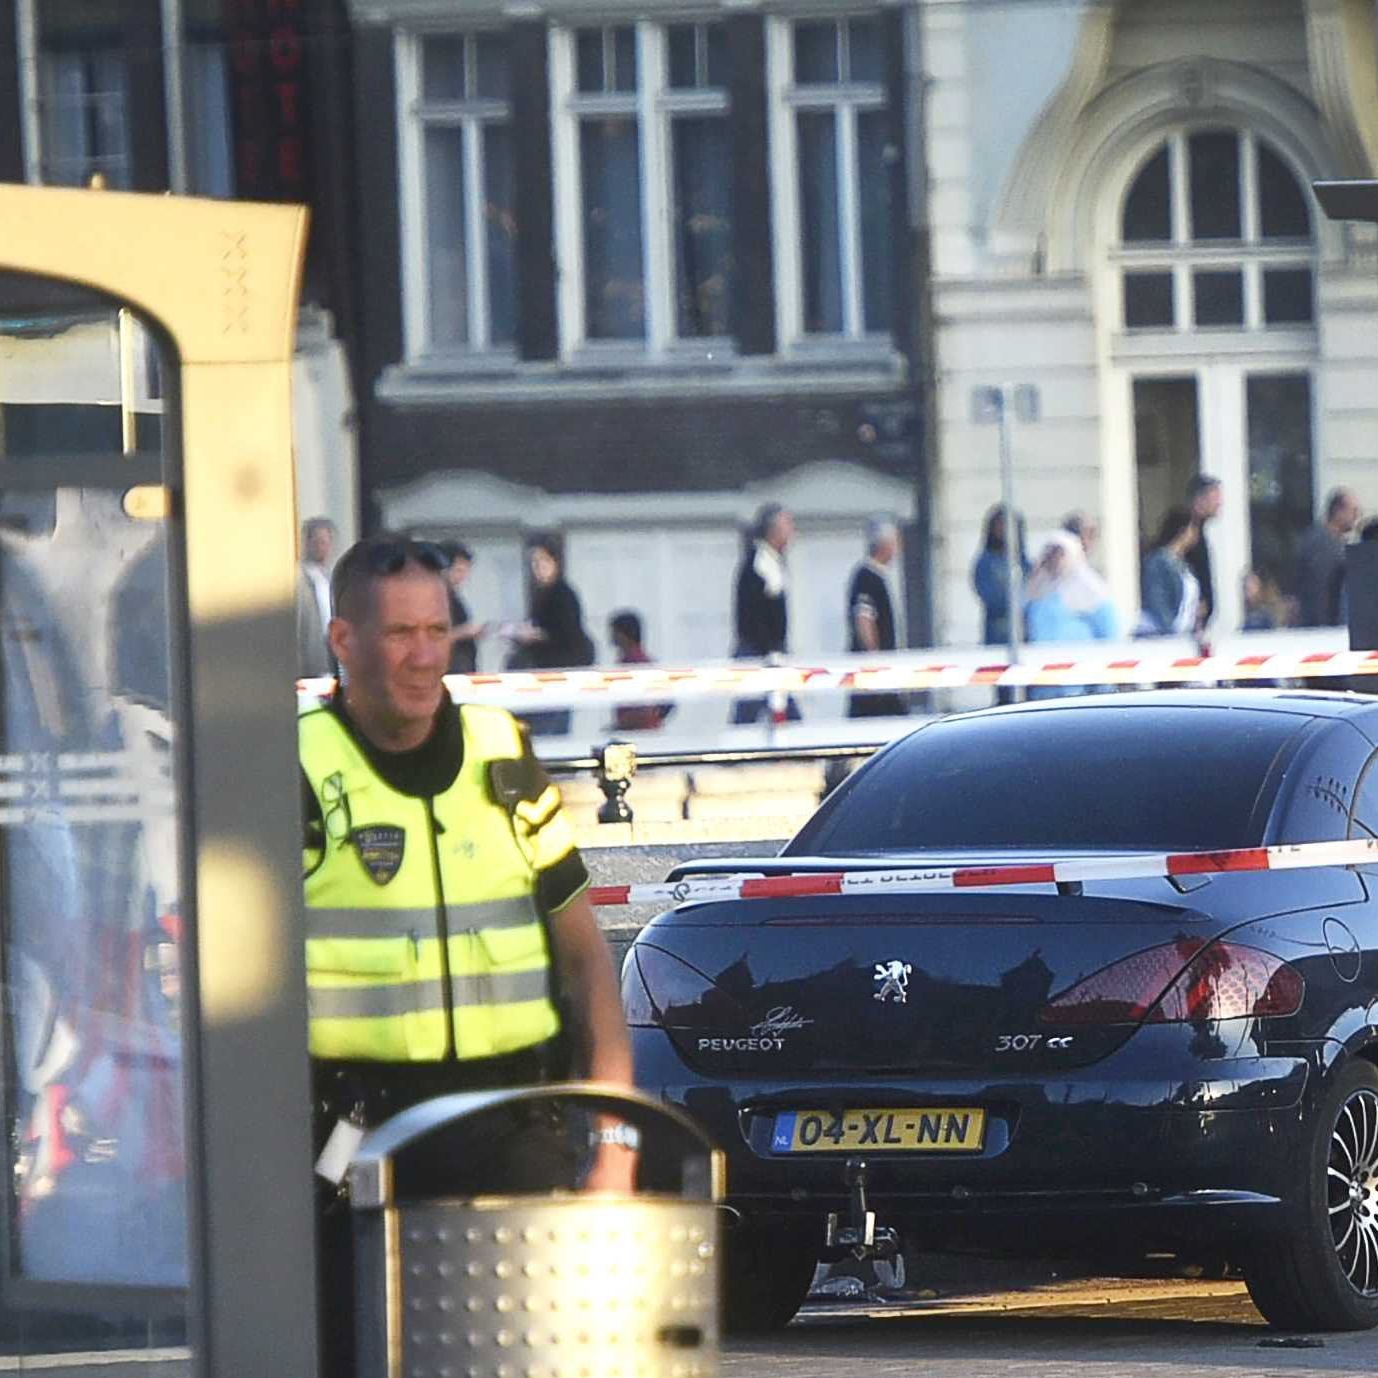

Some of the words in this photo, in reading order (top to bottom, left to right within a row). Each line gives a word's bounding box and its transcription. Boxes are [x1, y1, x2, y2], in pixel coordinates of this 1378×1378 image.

[698, 1037, 785, 1051] PEUGEOT
[995, 1034, 1042, 1052] 307
[798, 1112, 970, 1147] 04-XL-NN
[774, 1135, 789, 1146] NL
